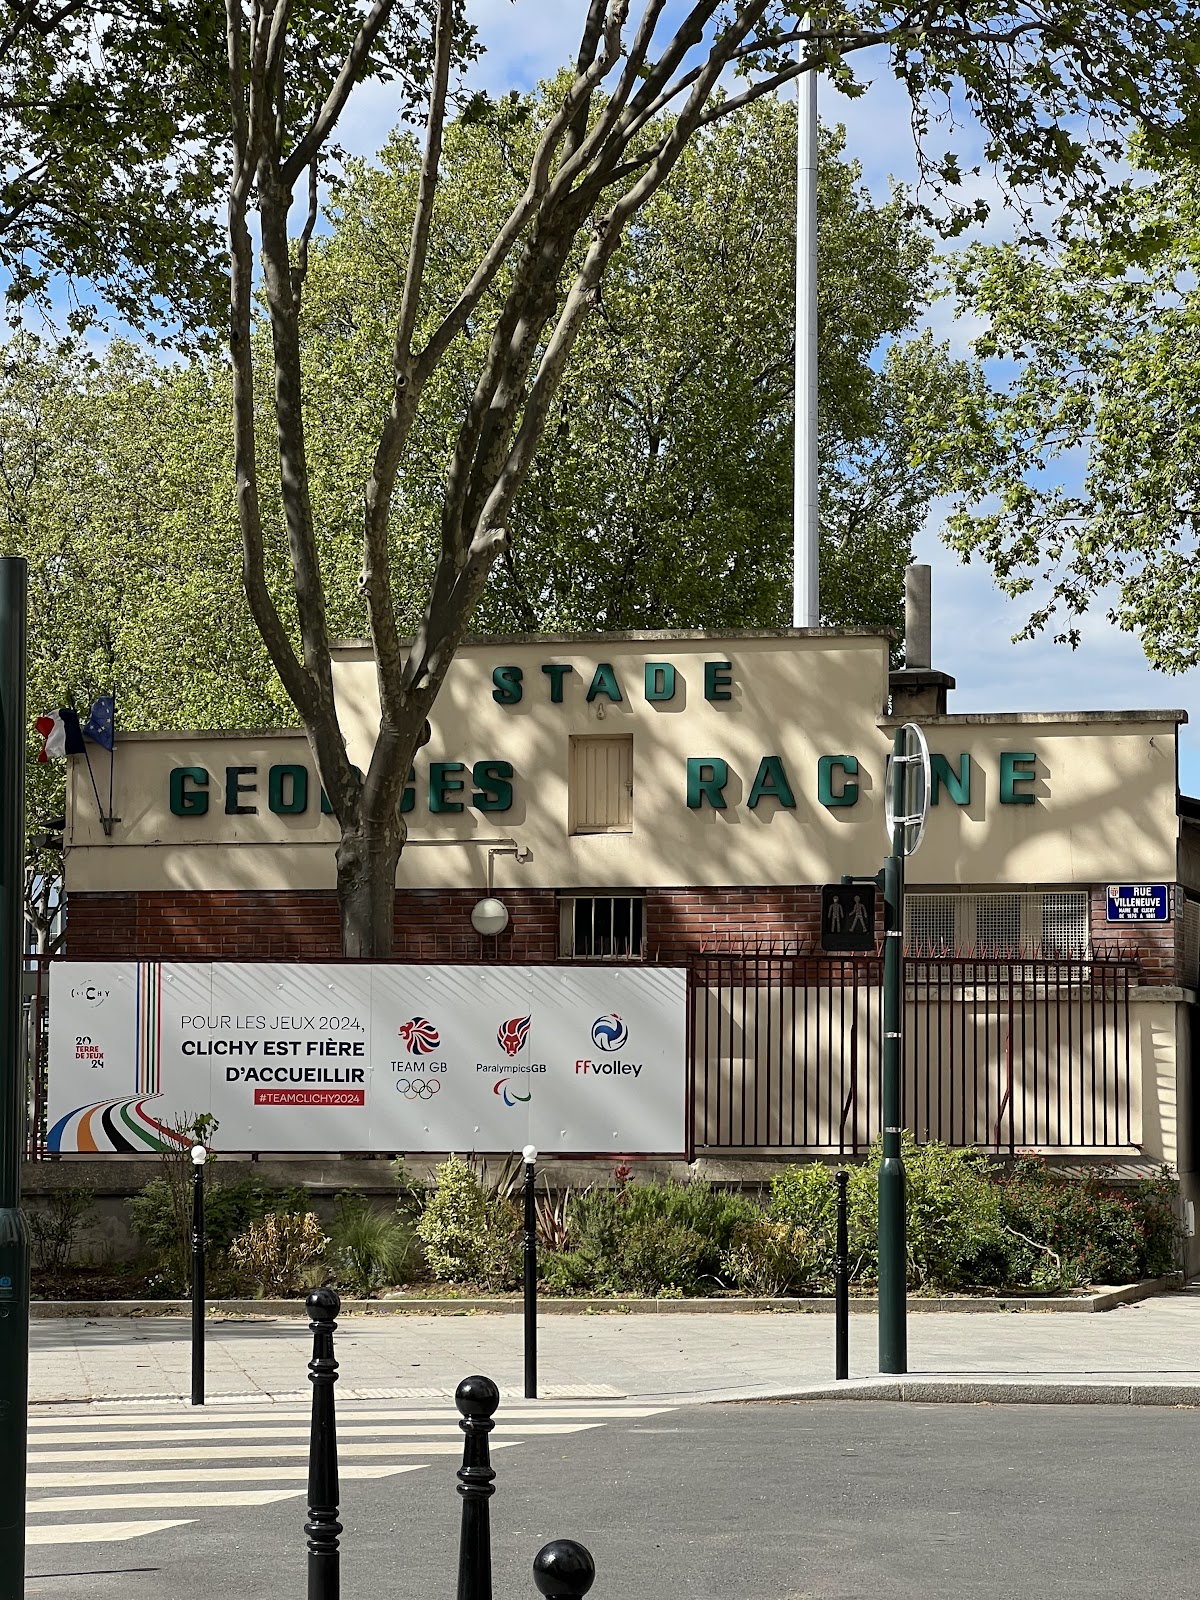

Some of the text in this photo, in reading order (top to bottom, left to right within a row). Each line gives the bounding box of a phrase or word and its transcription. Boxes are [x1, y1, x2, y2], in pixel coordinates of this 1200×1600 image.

[491, 661, 733, 705] STADE
[686, 752, 1037, 810] RACNE
[1134, 887, 1152, 896] RUE
[1114, 898, 1160, 906] VILLENEUVE
[181, 1015, 365, 1033] POUR LES JEUX 2024,
[75, 1036, 92, 1045] 20
[181, 1037, 365, 1057] CLICHY EST FIÈRE
[91, 1060, 104, 1069] 24
[390, 1061, 448, 1073] TEAM GB
[476, 1063, 547, 1074] ParalympicsGB
[575, 1060, 643, 1078] FFvolley
[225, 1066, 365, 1083] D’ACCUEILLIR
[259, 1093, 360, 1103] #TEAMCLICHY2024
